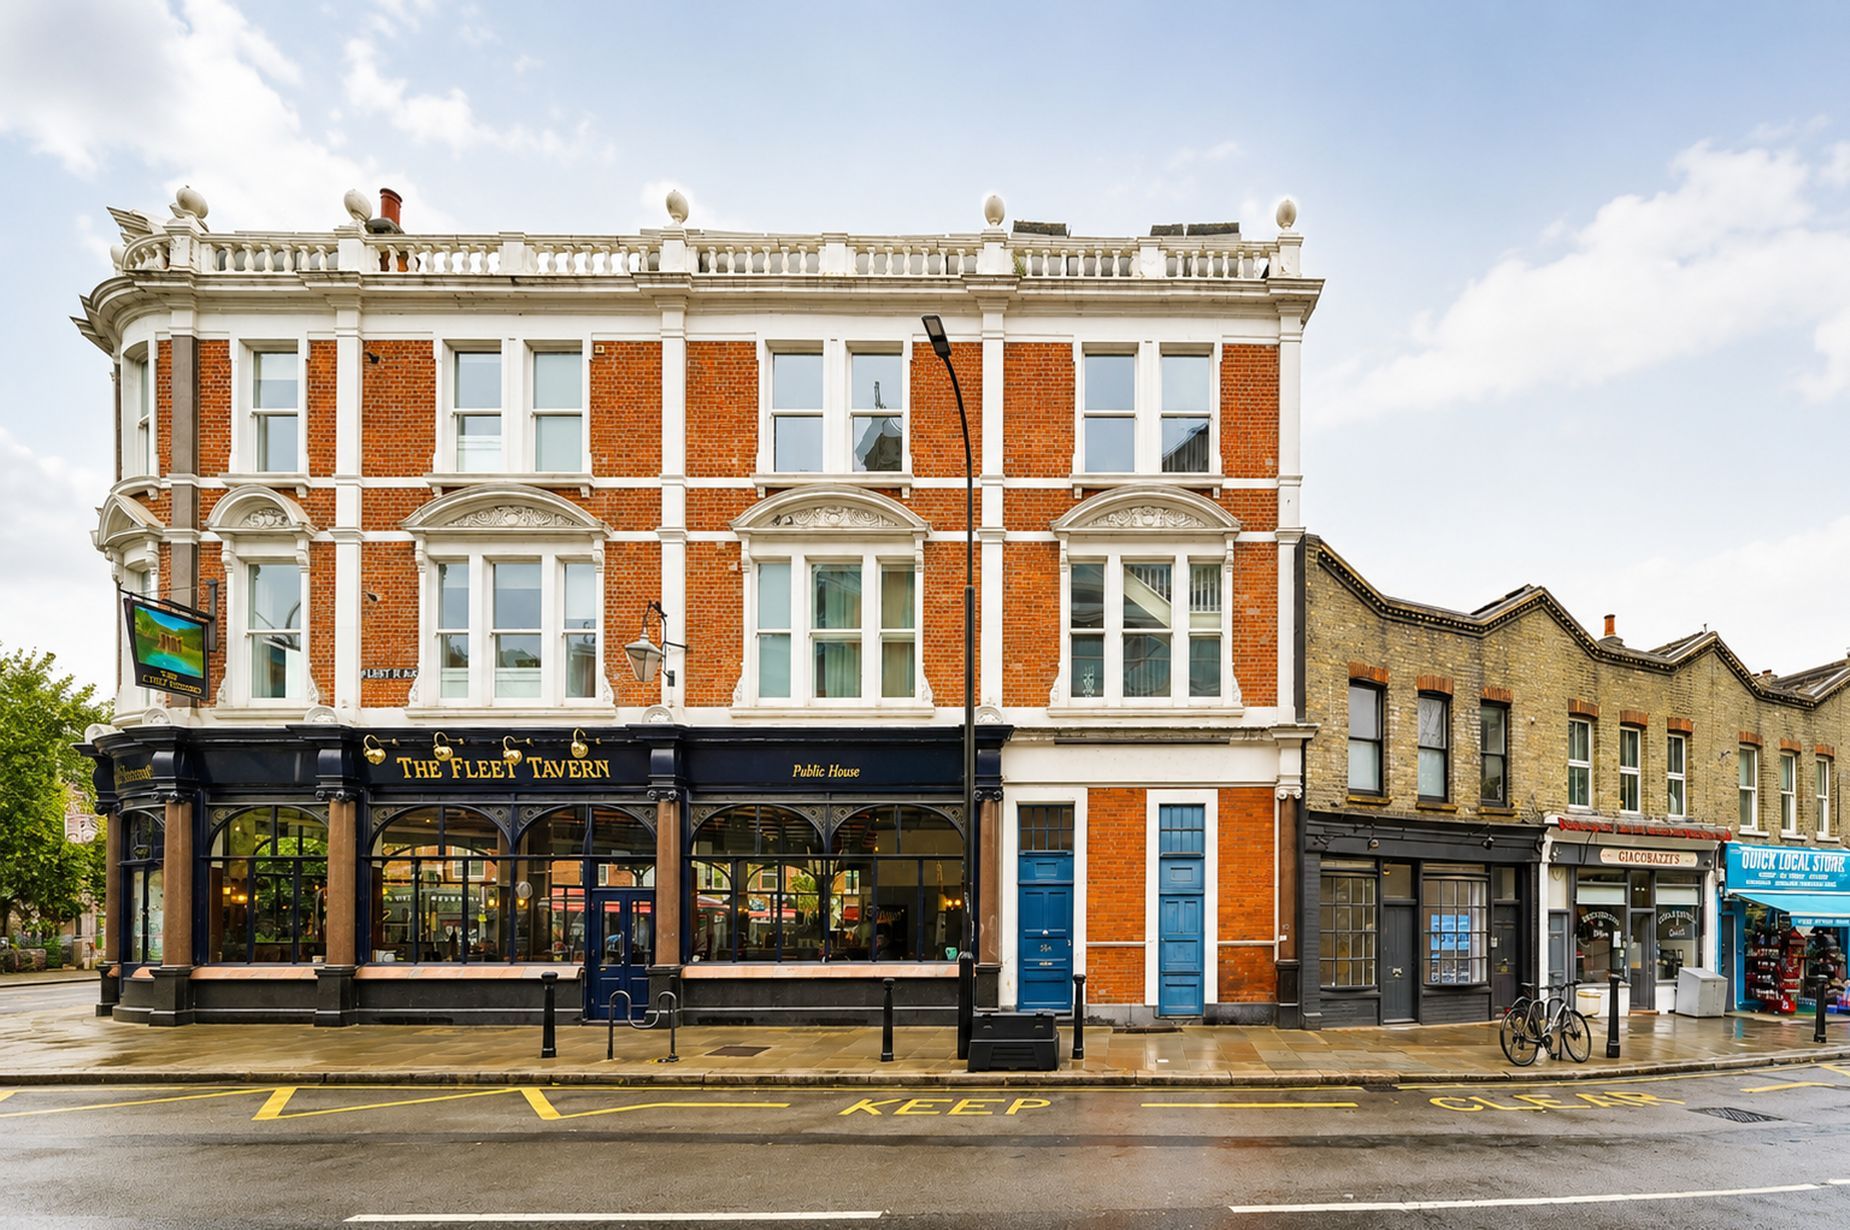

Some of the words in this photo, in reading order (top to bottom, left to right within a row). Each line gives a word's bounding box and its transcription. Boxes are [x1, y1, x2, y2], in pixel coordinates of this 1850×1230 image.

[396, 757, 442, 779] THE
[451, 757, 517, 779] FLEET
[526, 756, 611, 779] TAVERN
[792, 763, 825, 778] Public
[828, 763, 860, 778] House
[1779, 853, 1810, 871] LOCAL
[1813, 855, 1845, 872] STORE
[837, 1098, 1052, 1115] KEEP
[1429, 1091, 1686, 1111] CLEAR
